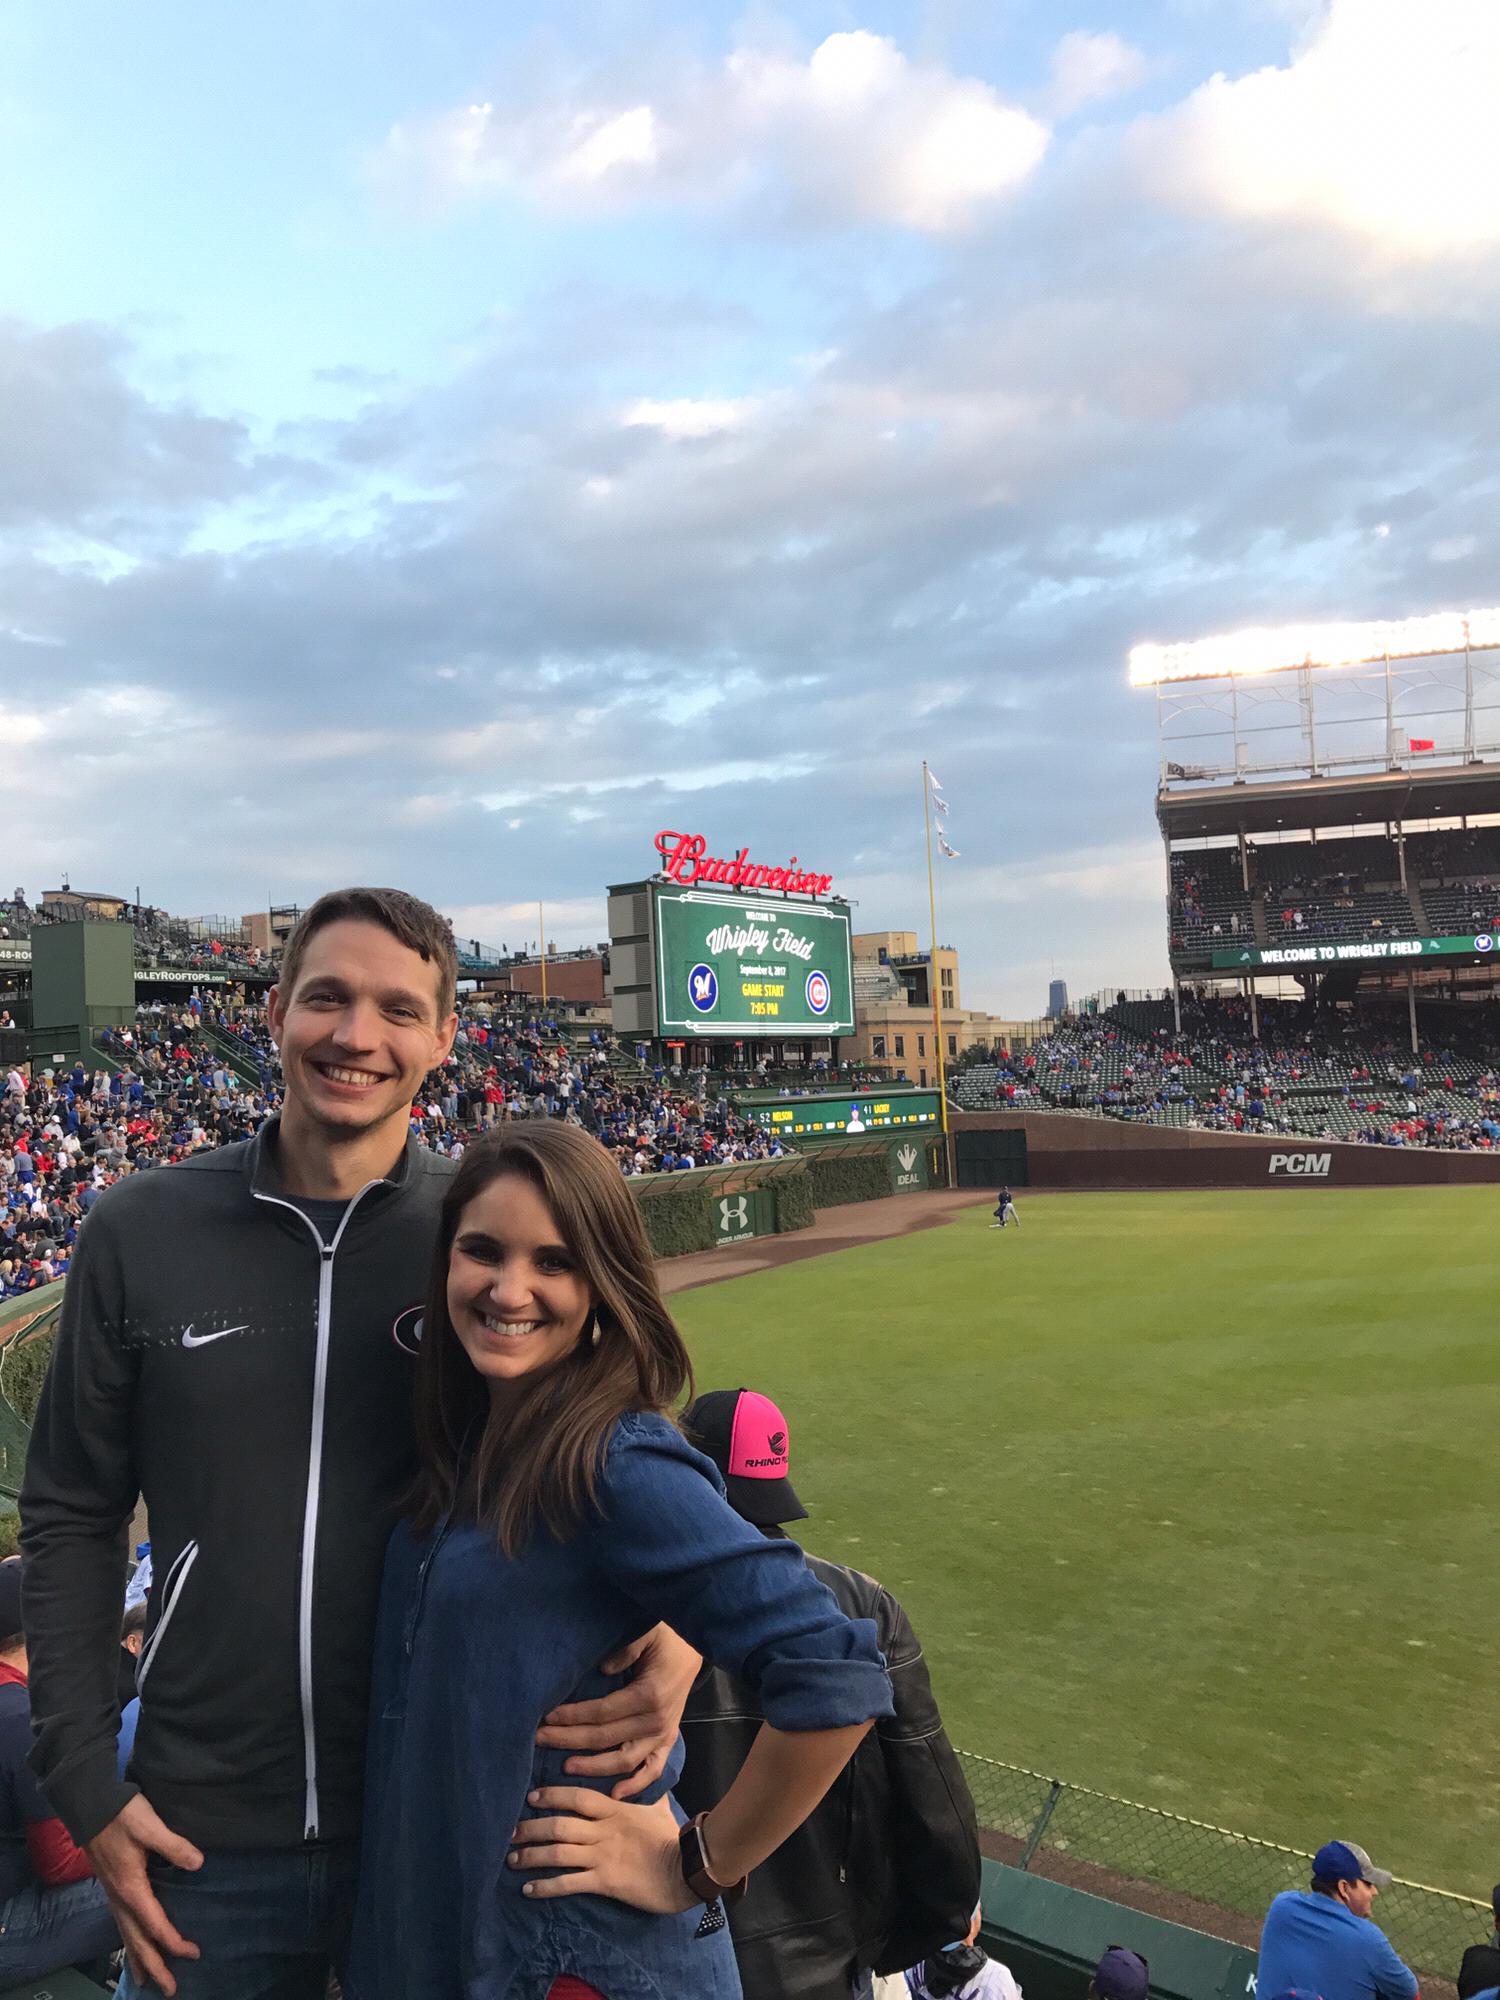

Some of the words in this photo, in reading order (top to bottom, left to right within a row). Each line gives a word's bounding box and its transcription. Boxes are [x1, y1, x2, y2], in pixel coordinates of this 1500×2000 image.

[655, 830, 833, 896] Budweiser
[706, 923, 769, 956] Wrigley
[773, 928, 815, 960] Field
[1260, 947, 1317, 963] WELCOME
[1319, 946, 1335, 959] TO
[1336, 943, 1387, 958] WRIGLEY
[1390, 941, 1422, 955] FIELD
[742, 983, 762, 997] GAME
[764, 985, 784, 997] START
[750, 1002, 766, 1015] 7:05
[766, 1002, 778, 1015] PM
[1268, 1153, 1331, 1173] PCM
[897, 1173, 919, 1185] IDEAL
